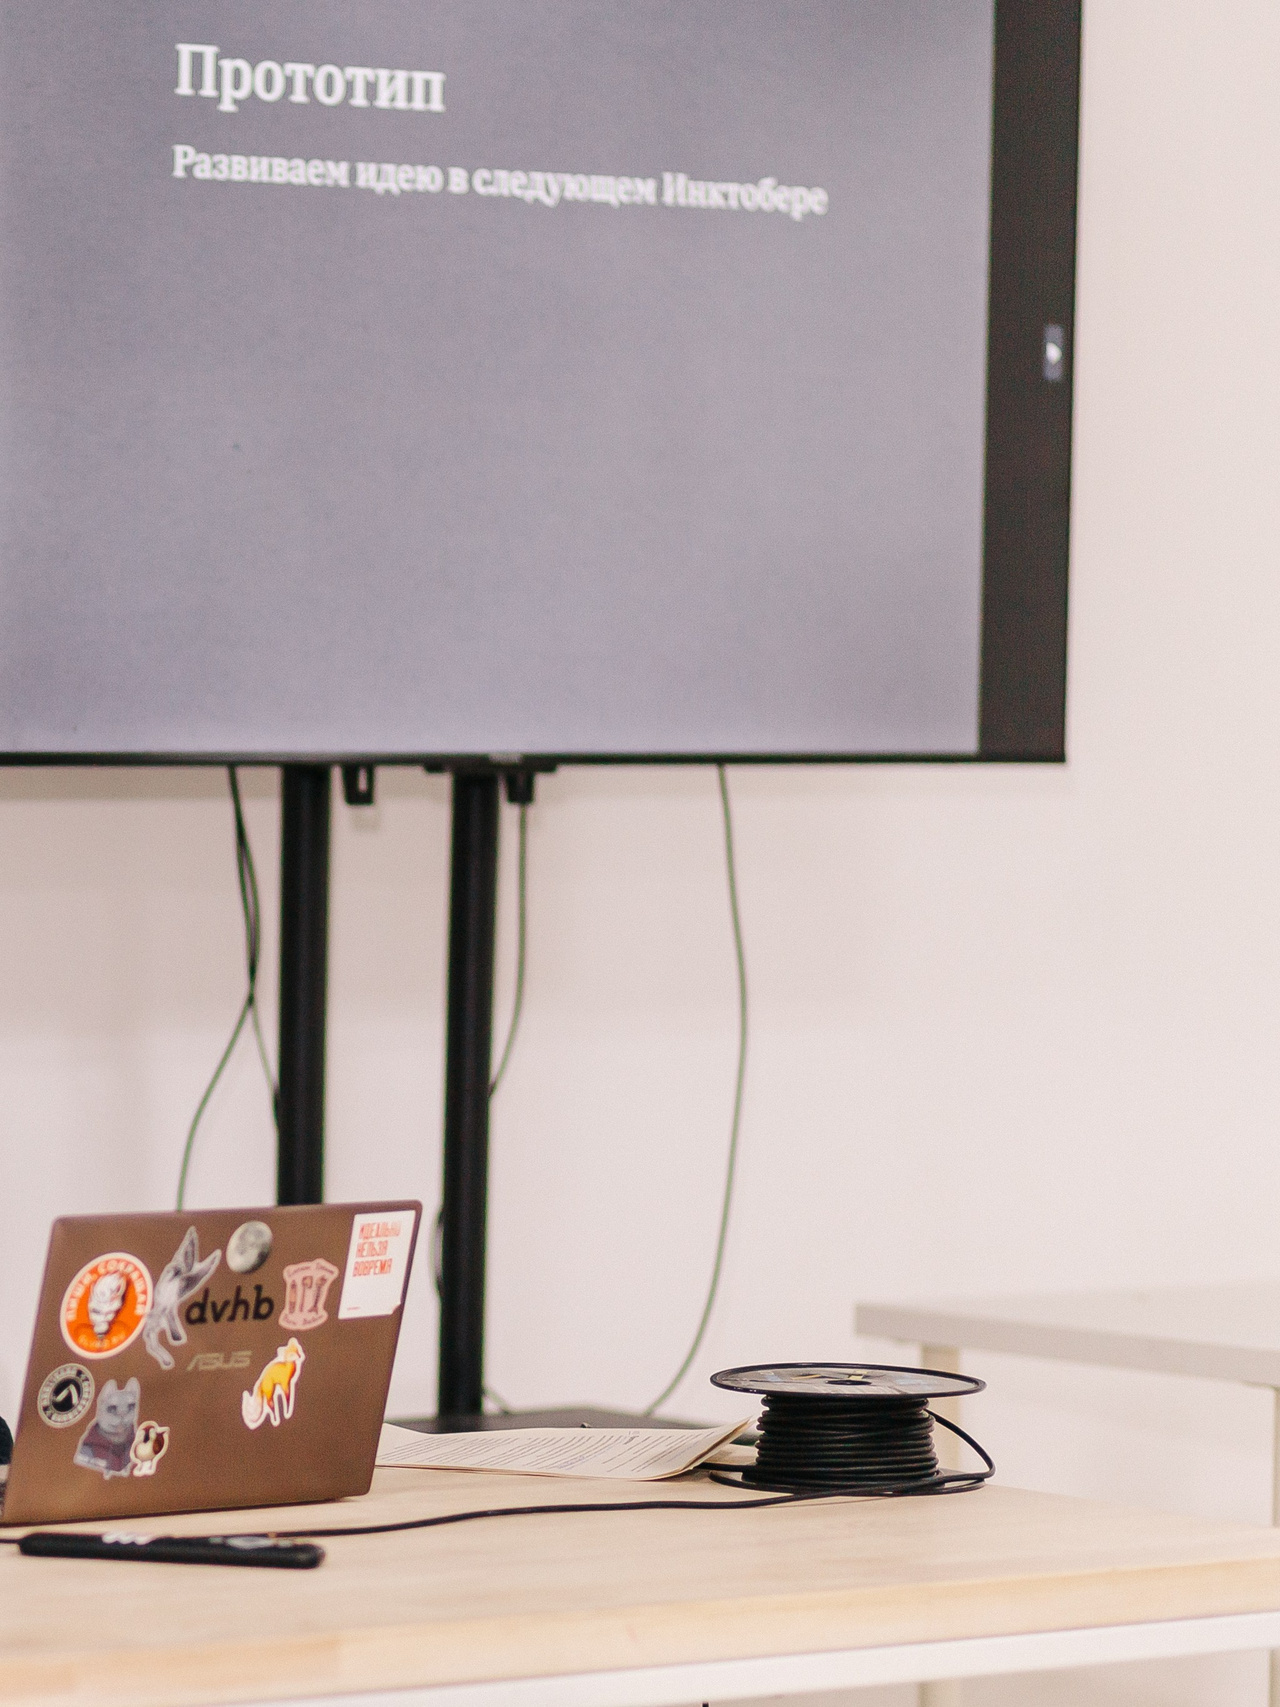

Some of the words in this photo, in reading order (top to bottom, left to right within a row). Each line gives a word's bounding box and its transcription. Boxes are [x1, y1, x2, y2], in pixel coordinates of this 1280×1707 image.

[174, 43, 446, 112] Прототип
[172, 144, 351, 188] Развиваем
[355, 161, 443, 196] идею
[446, 166, 469, 194] в
[472, 168, 657, 208] следующем
[662, 171, 828, 221] Инктобере
[184, 1284, 275, 1325] dvhb
[185, 1350, 253, 1372] ASUS
